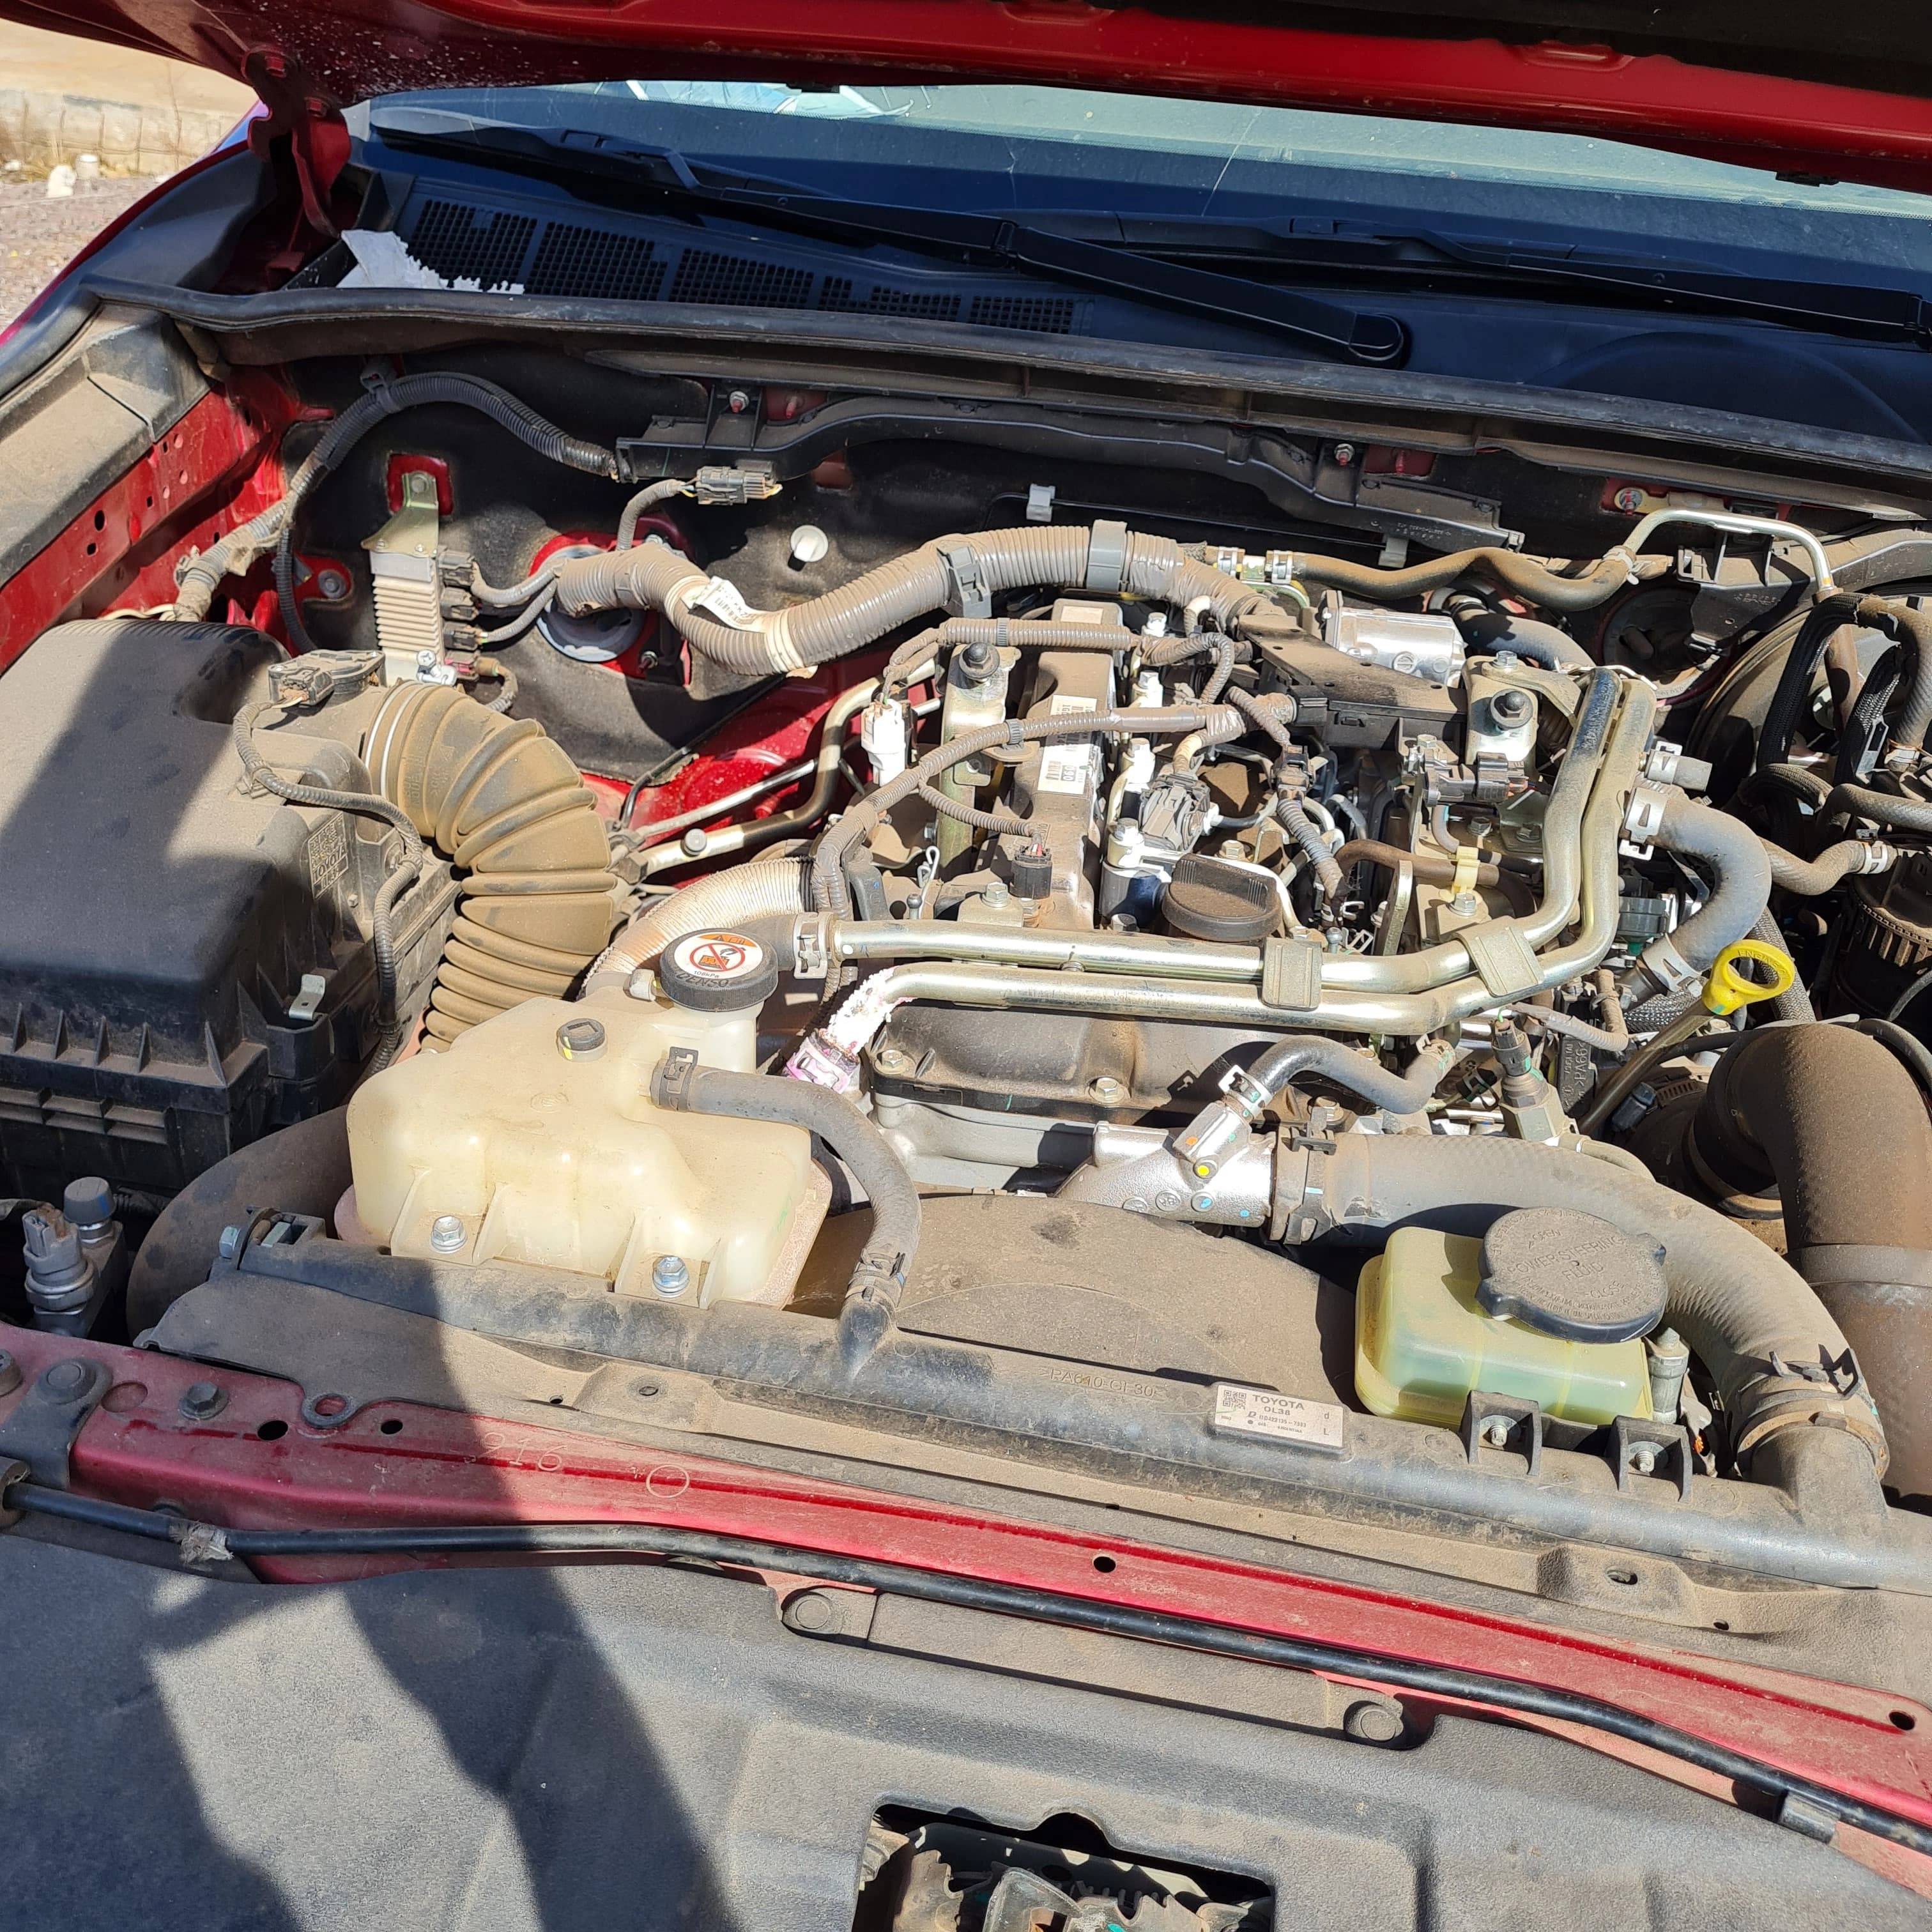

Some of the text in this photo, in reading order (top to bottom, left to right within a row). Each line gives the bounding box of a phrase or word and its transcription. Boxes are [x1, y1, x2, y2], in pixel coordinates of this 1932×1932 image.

[675, 972, 729, 988] DENSO
[694, 970, 720, 979] 108kPa
[1507, 1236, 1624, 1275] POWER STEERING
[1561, 1261, 1604, 1281] FLUID
[1252, 1394, 1305, 1411] TOYOTA
